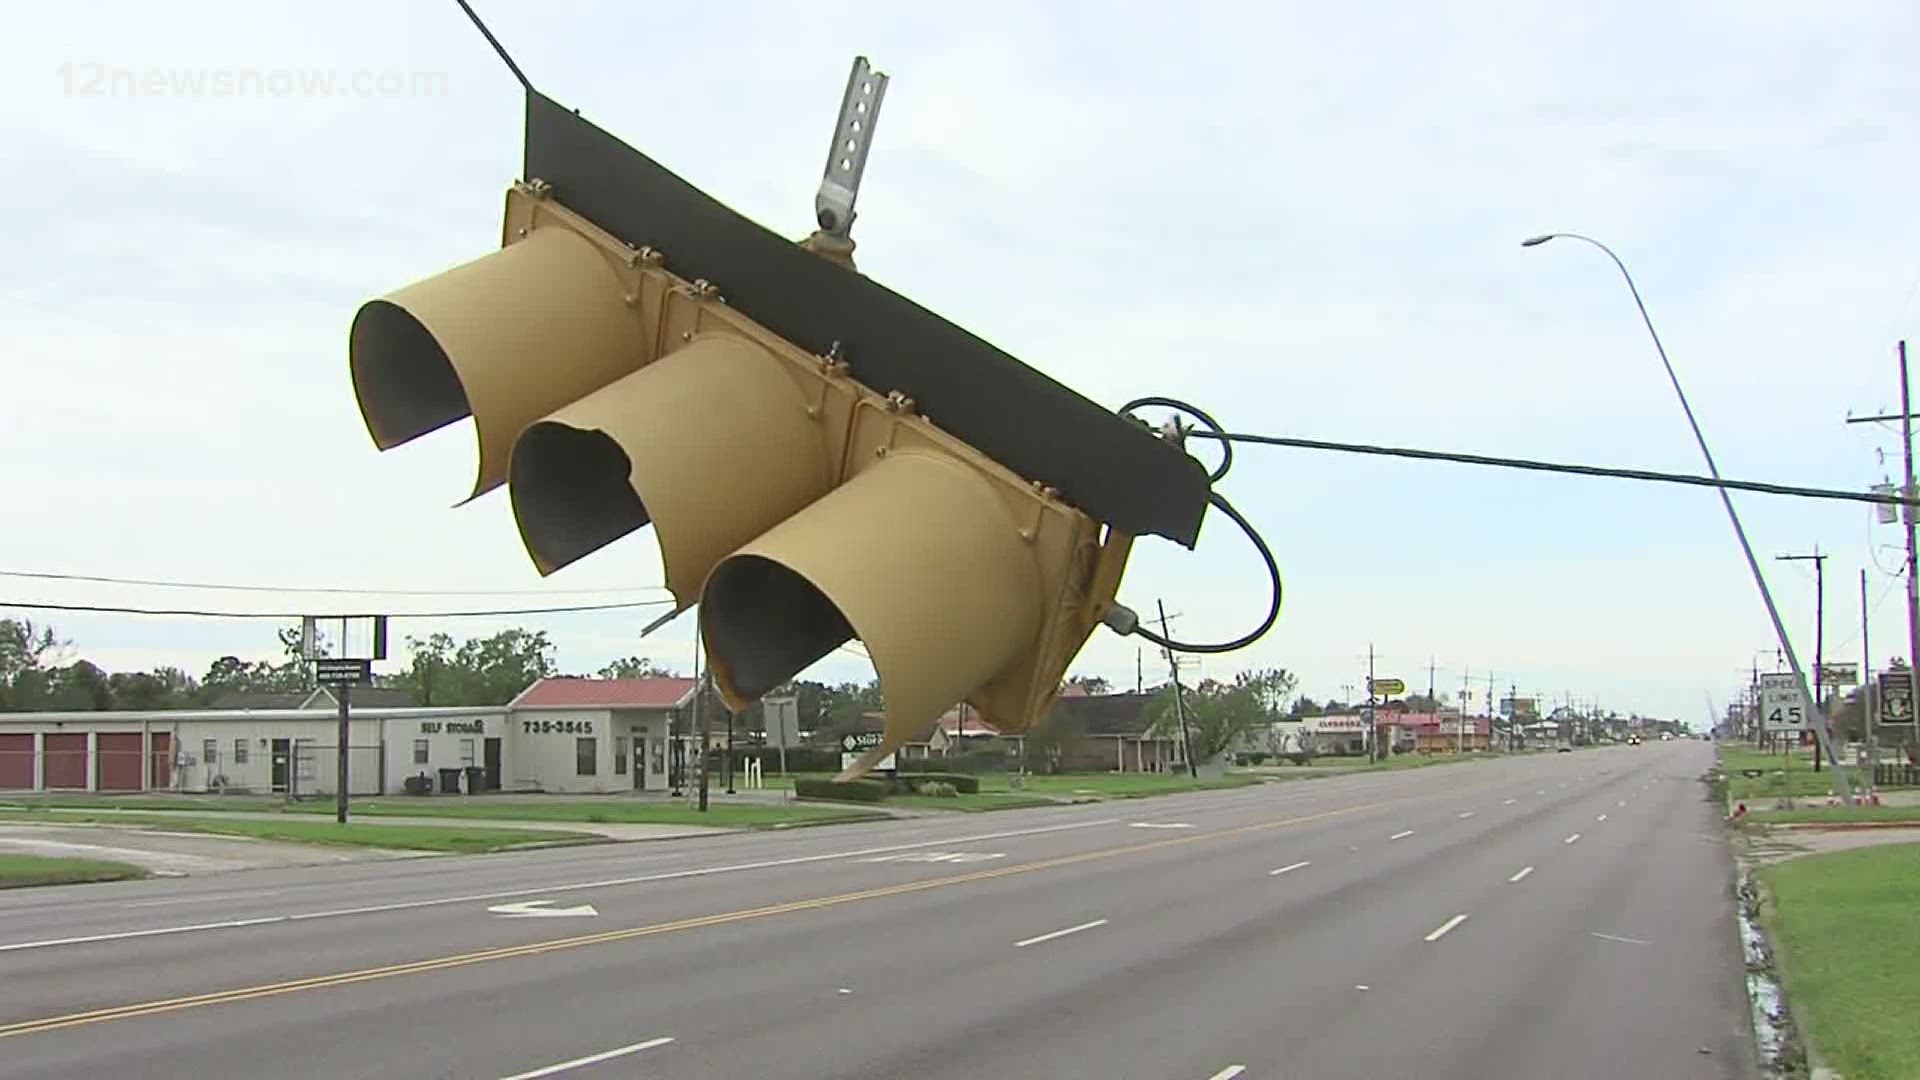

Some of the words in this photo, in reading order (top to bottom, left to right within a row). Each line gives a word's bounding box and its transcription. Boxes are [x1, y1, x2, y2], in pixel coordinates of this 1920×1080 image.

[1769, 693, 1798, 703] LIMIT
[1768, 707, 1801, 724] 45
[421, 722, 441, 734] SELF
[523, 720, 593, 734] 735-3545
